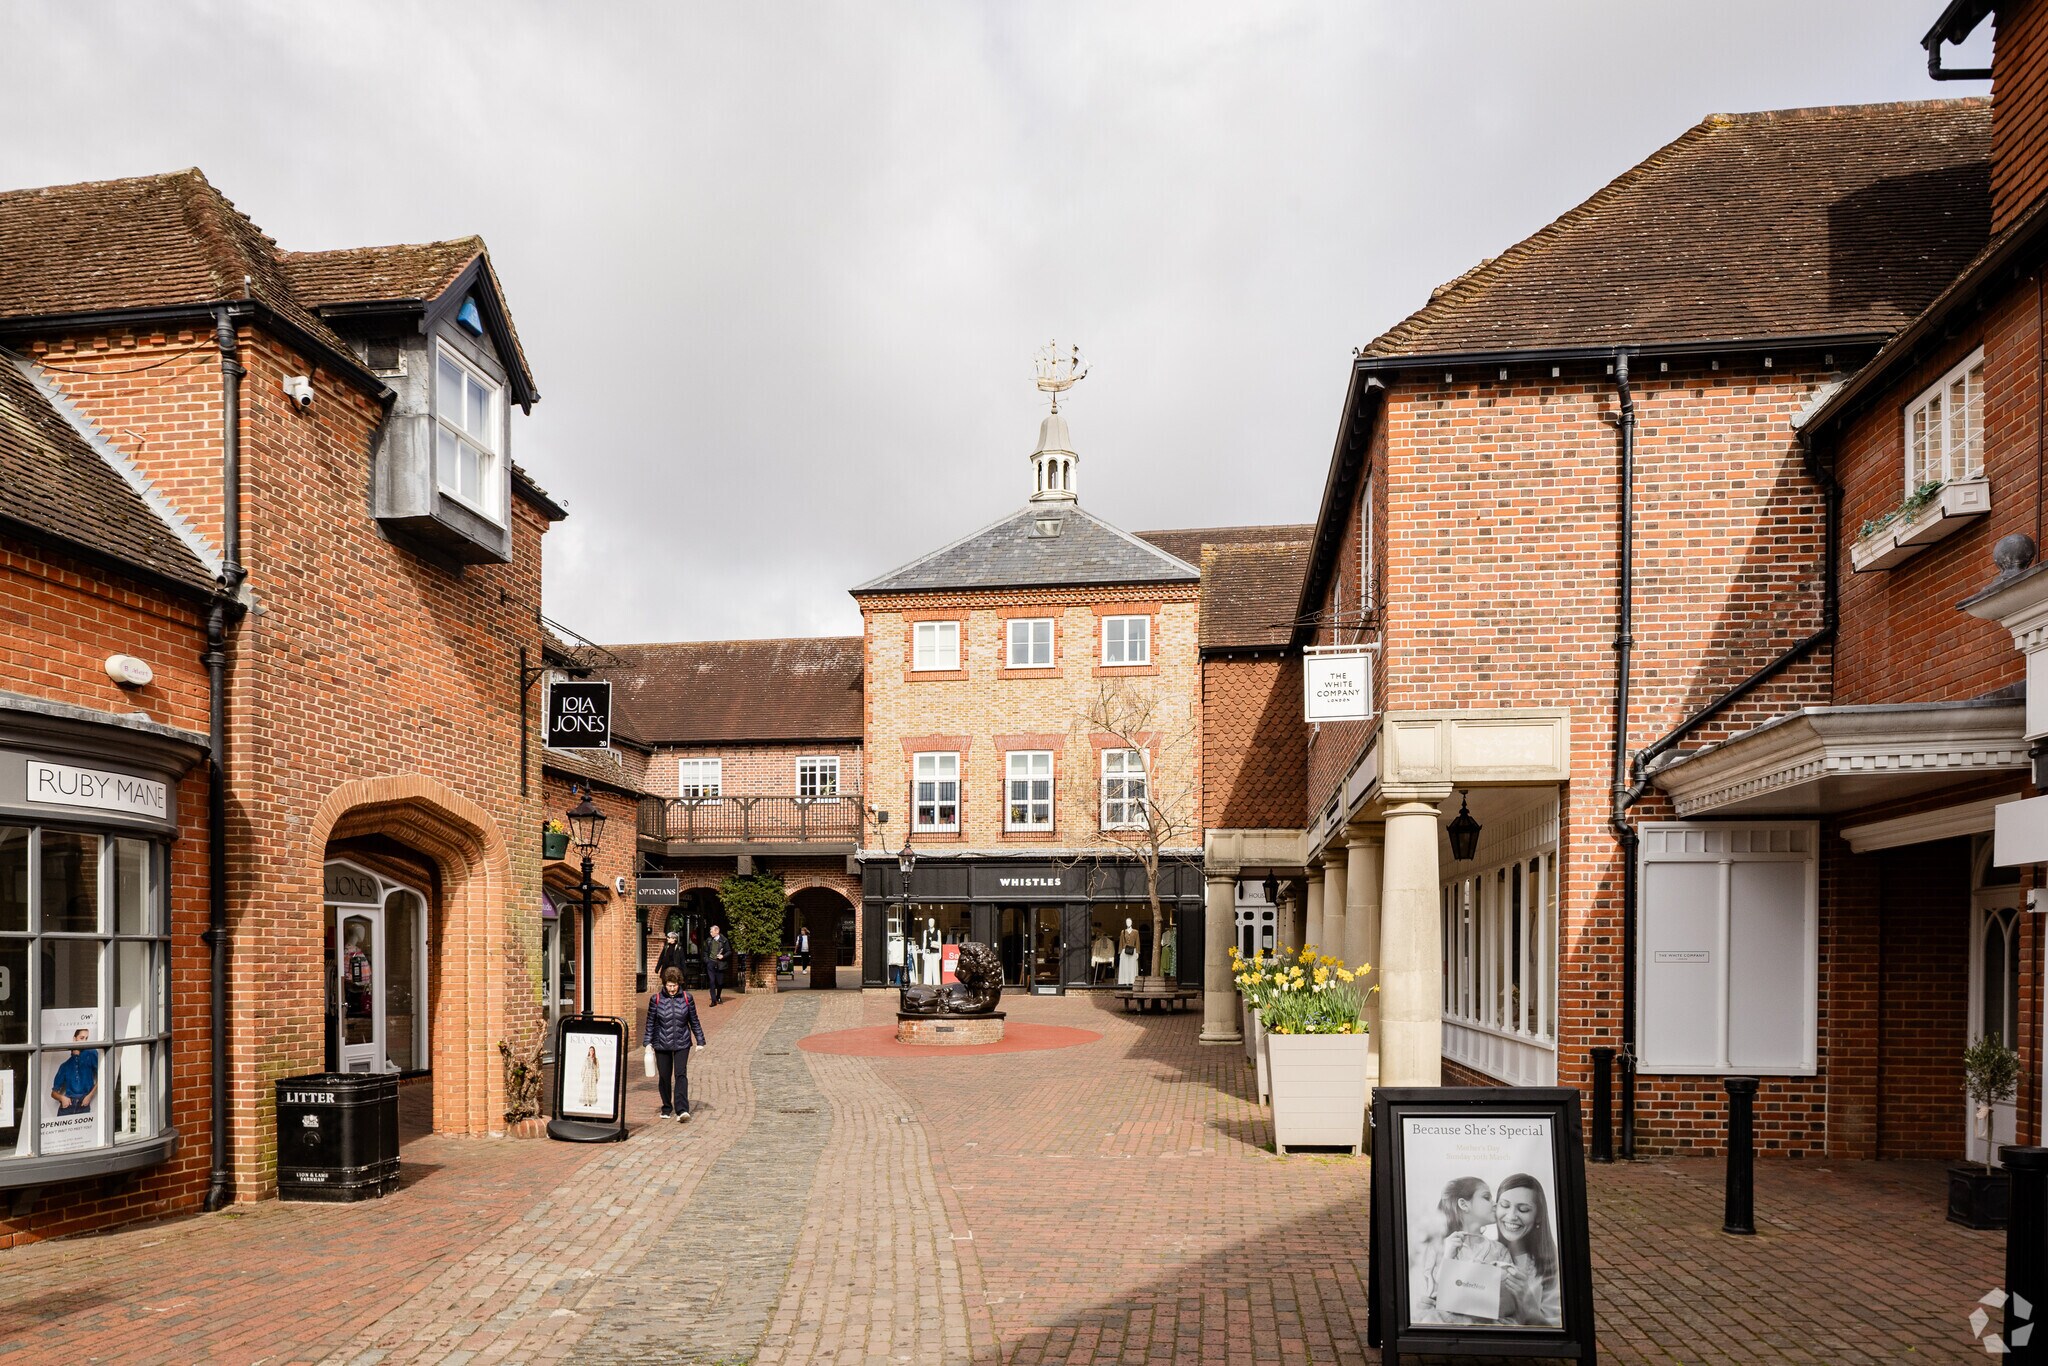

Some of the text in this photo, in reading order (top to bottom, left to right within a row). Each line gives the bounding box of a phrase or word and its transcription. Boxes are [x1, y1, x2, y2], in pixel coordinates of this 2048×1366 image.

[1330, 672, 1347, 680] THE
[1324, 680, 1353, 688] WHITE
[1316, 689, 1360, 698] COMPANY
[562, 696, 597, 714] LOLA
[552, 715, 605, 733] JONES
[39, 768, 164, 809] RUBY MANE
[331, 876, 373, 898] JONES
[999, 877, 1062, 887] WHISTLES
[638, 888, 677, 896] OPTICIANS
[948, 952, 960, 960] Sa
[286, 1092, 336, 1104] LITTER
[40, 1116, 94, 1129] OPENING SOON
[1412, 1123, 1544, 1140] Because She's Special
[1487, 1144, 1500, 1153] Day
[1446, 1153, 1472, 1162] Sunday
[1489, 1153, 1511, 1161] March
